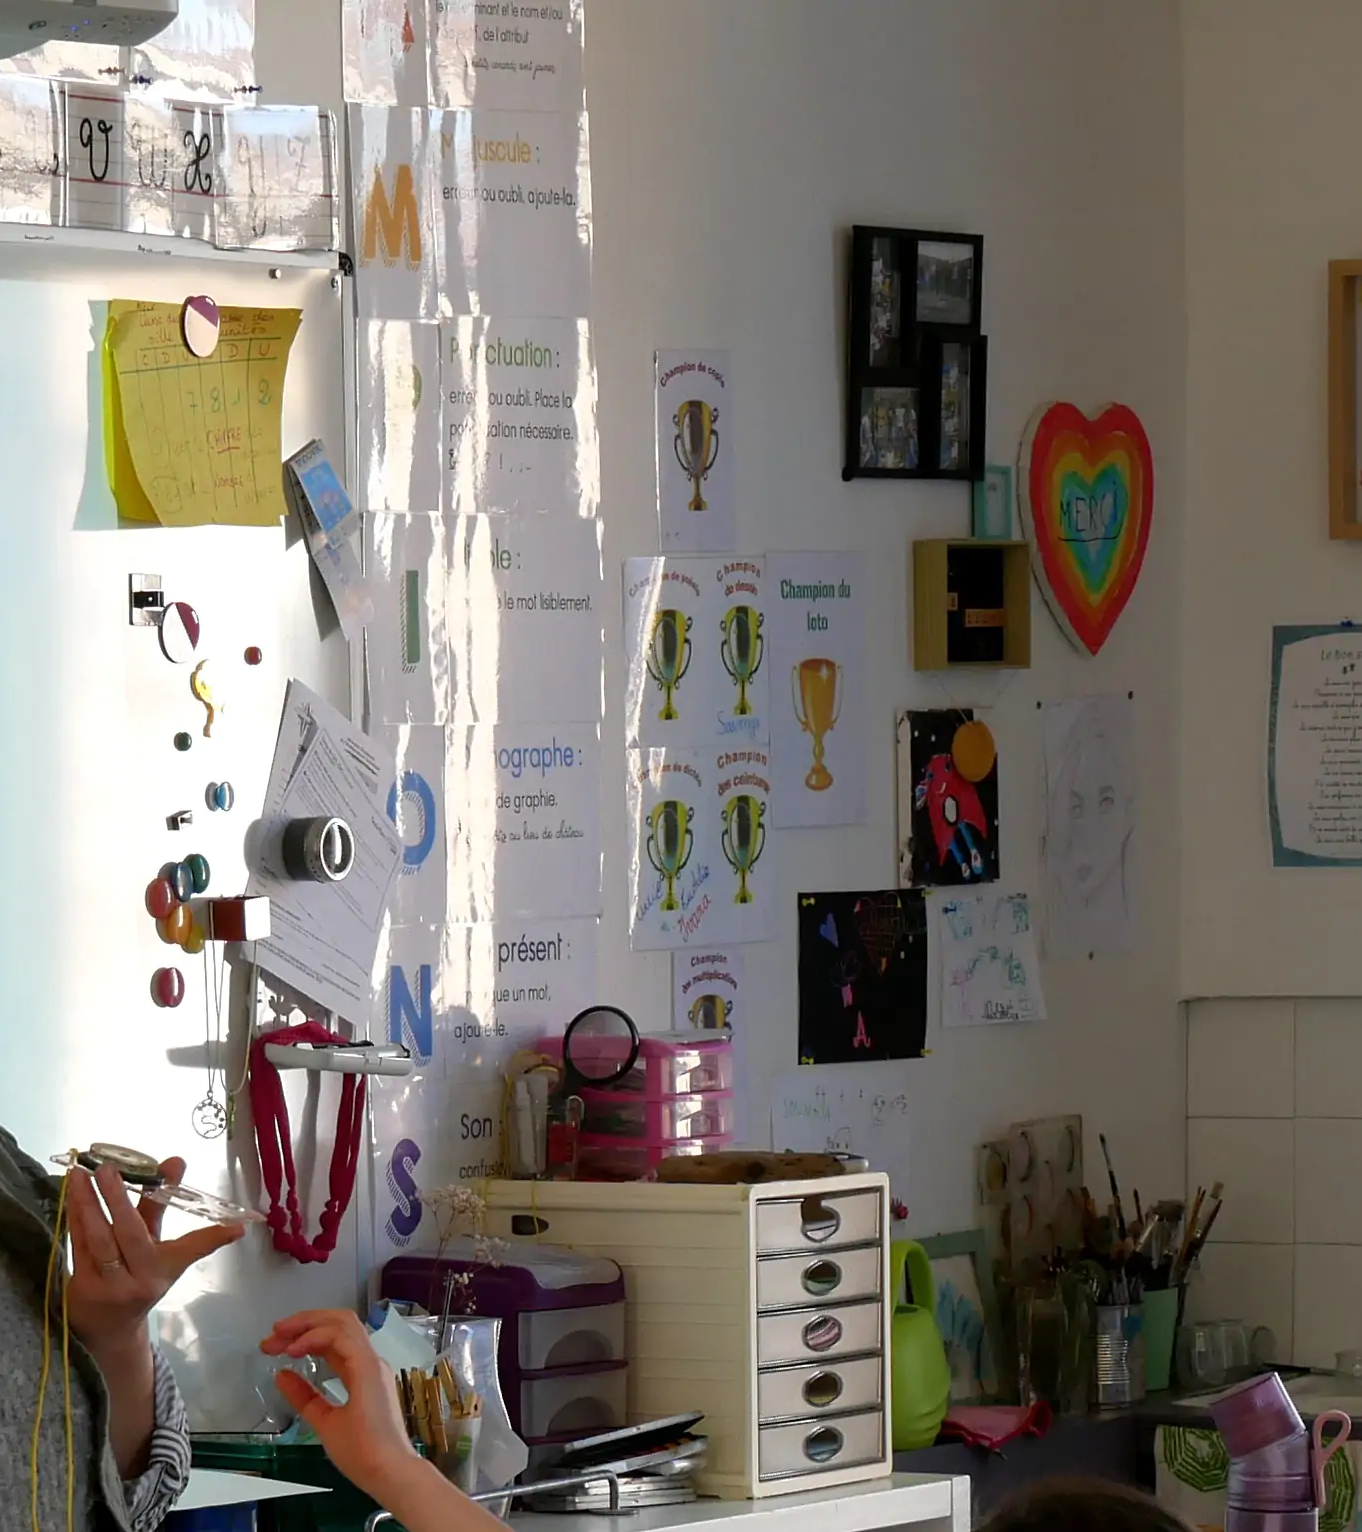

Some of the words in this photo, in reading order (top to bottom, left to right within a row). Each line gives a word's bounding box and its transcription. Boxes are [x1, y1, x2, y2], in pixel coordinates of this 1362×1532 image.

[441, 131, 533, 171] Mjuscule
[482, 187, 496, 202] ou
[450, 336, 553, 369] Pnctuation
[489, 391, 503, 406] ou
[535, 388, 560, 408] Place
[562, 390, 573, 409] la
[504, 590, 514, 611] le
[517, 593, 537, 611] mot
[780, 578, 835, 602] Champion
[838, 578, 851, 598] du
[807, 611, 829, 632] loto
[717, 750, 768, 770] Champion
[496, 791, 511, 809] de
[513, 788, 559, 814] graphie.
[498, 932, 562, 972] présent
[512, 988, 526, 1002] un
[389, 963, 433, 1057] N
[460, 1112, 493, 1140] Son
